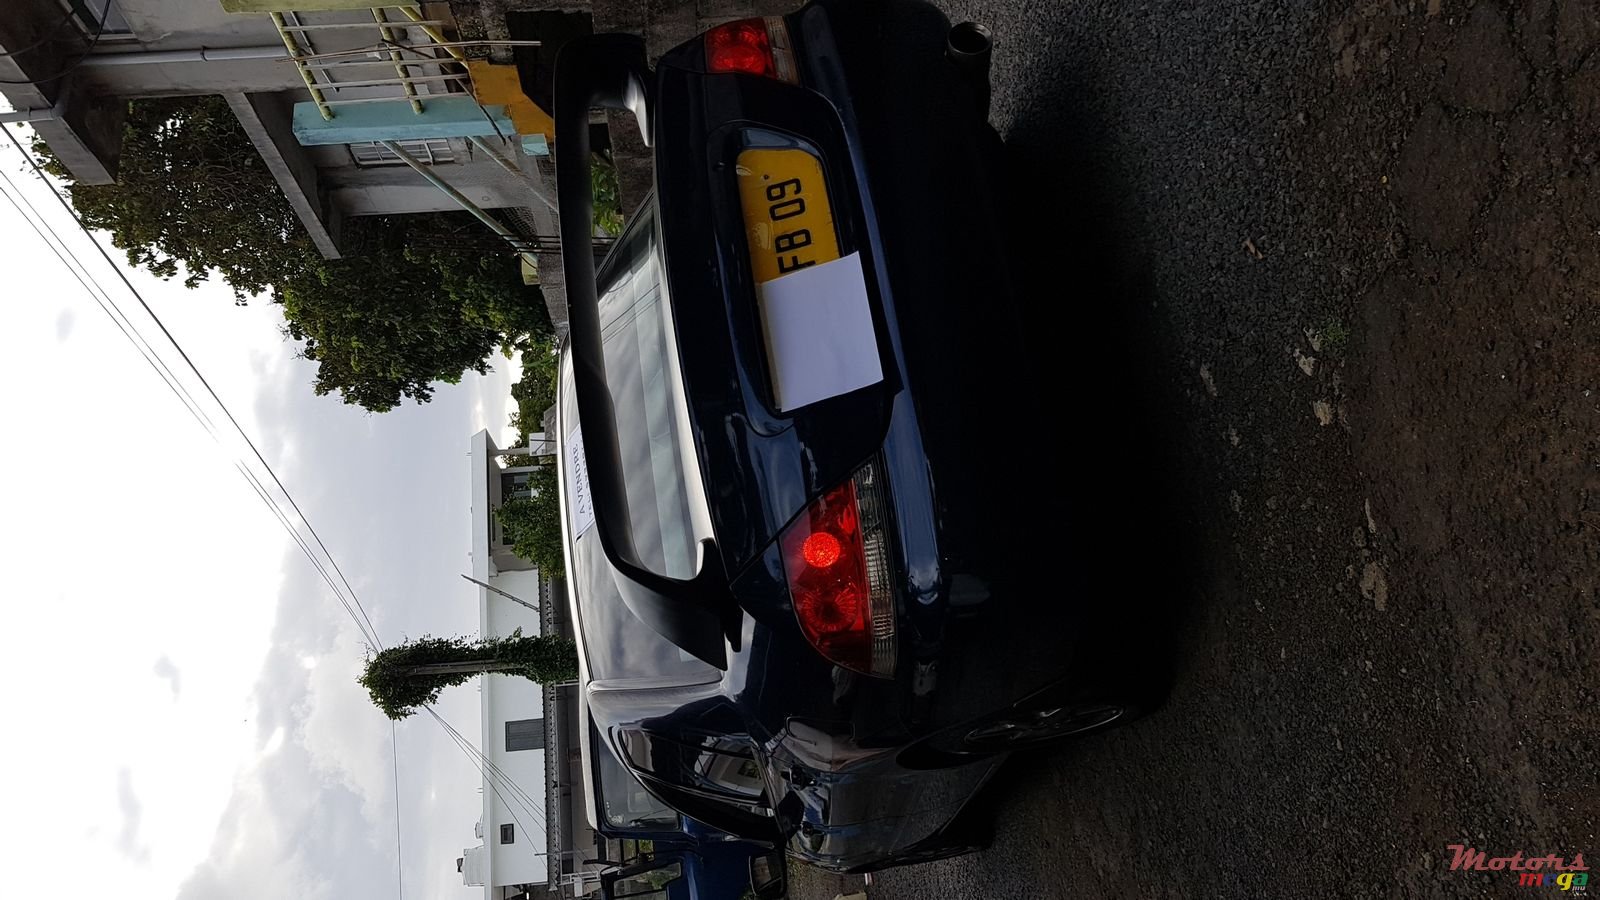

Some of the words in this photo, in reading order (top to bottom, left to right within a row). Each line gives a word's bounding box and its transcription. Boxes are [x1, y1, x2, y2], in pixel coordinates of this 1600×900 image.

[766, 178, 805, 221] 09
[775, 229, 816, 273] FB
[573, 444, 584, 503] VENDRE
